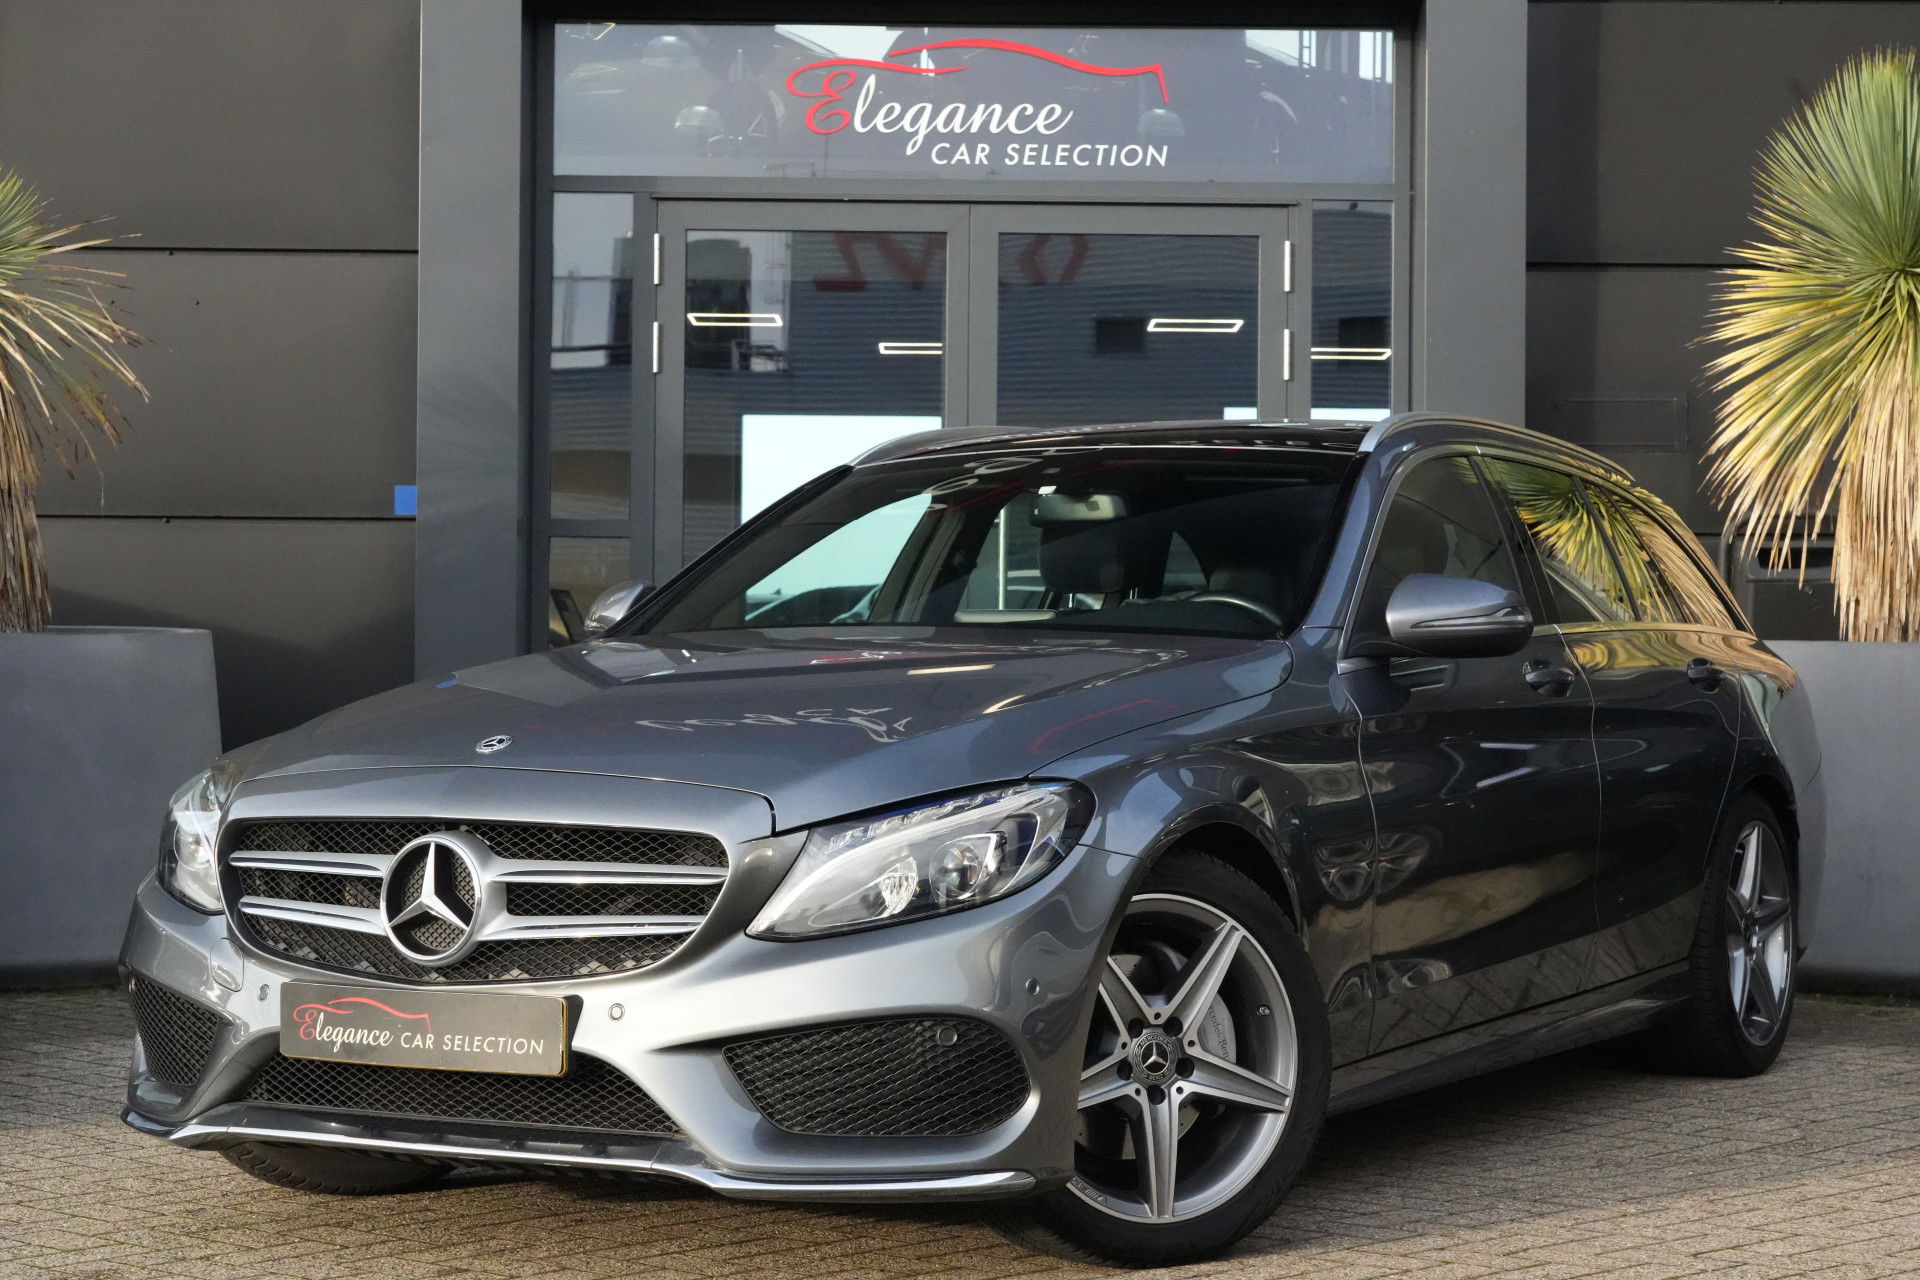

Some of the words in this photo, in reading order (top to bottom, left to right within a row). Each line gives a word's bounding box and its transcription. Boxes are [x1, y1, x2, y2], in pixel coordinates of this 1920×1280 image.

[785, 58, 1074, 156] Elegance
[930, 142, 991, 167] CAR
[1003, 142, 1169, 168] SELECTION
[291, 1001, 395, 1053] Elegance
[400, 1032, 435, 1050] CAR
[442, 1034, 544, 1056] SELECTION
